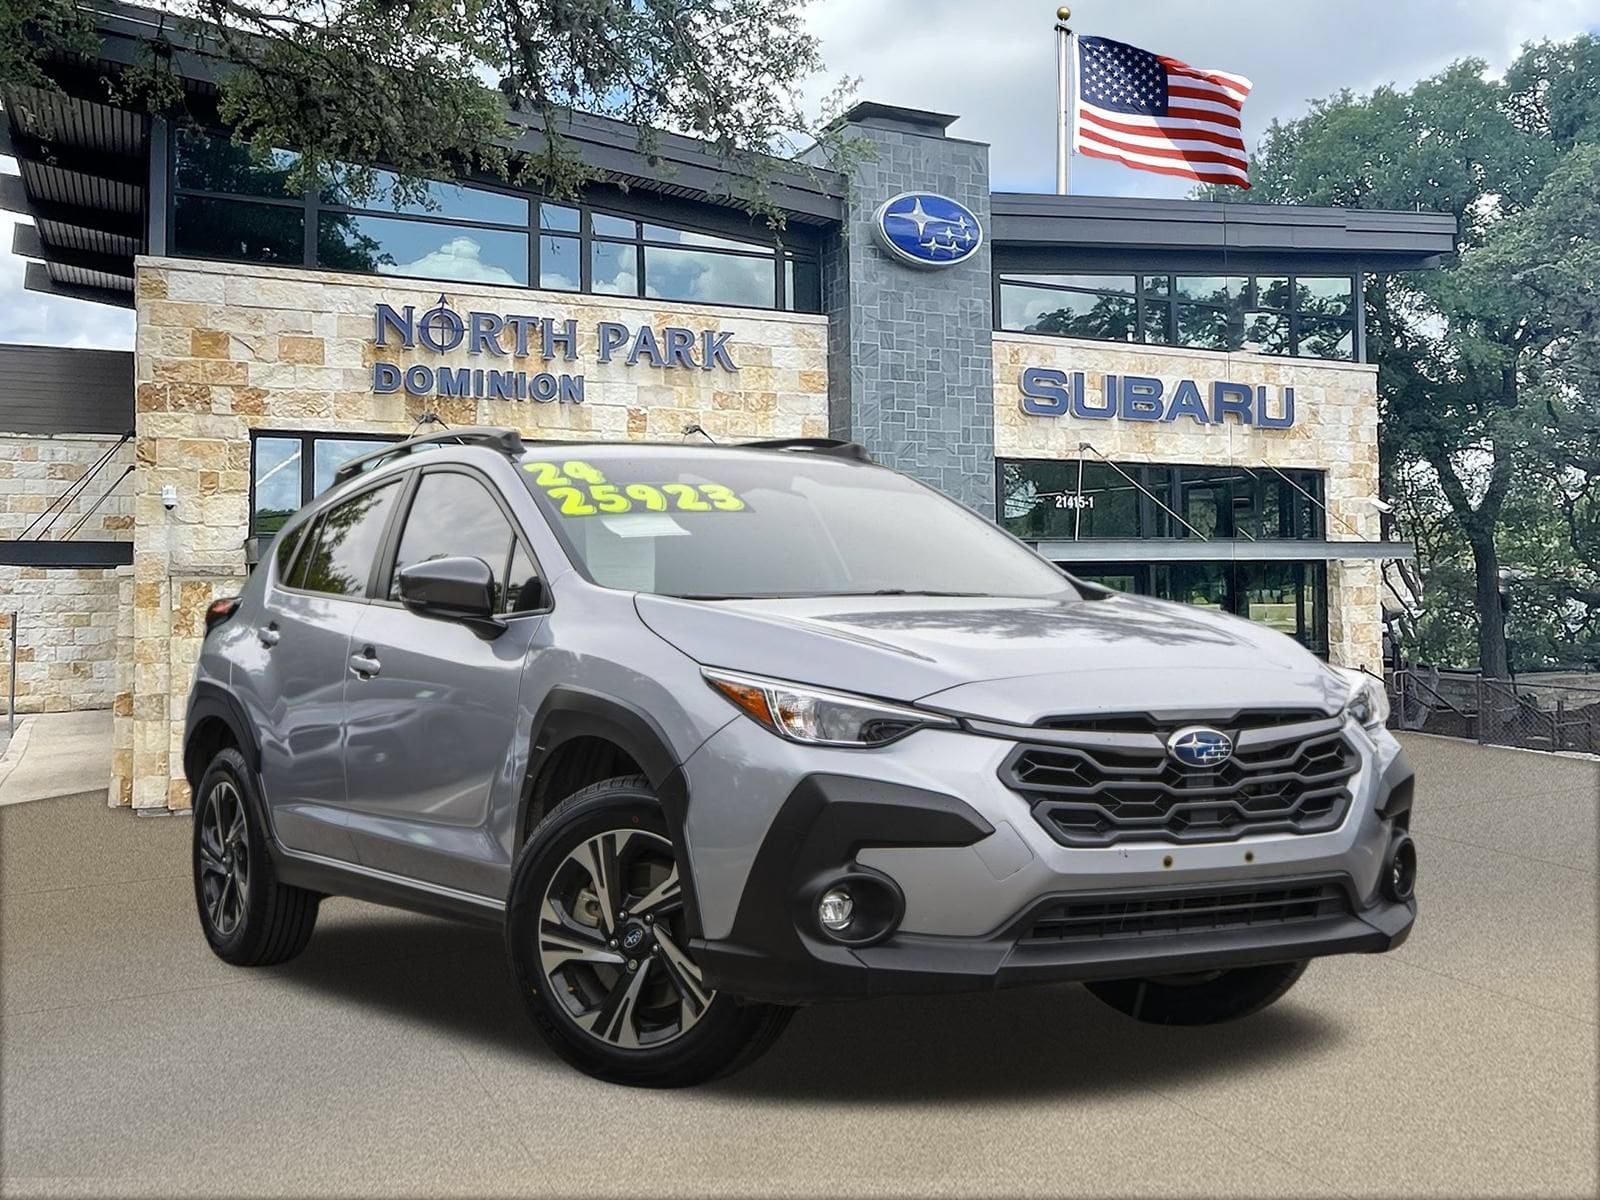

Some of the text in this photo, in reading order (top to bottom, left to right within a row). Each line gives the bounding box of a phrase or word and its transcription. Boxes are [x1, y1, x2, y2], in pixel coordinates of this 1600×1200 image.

[374, 296, 740, 373] NORTH PARK
[373, 362, 585, 404] DOMINION
[1020, 368, 1295, 429] SUBARU
[522, 461, 606, 486] 24
[547, 484, 745, 515] 25923
